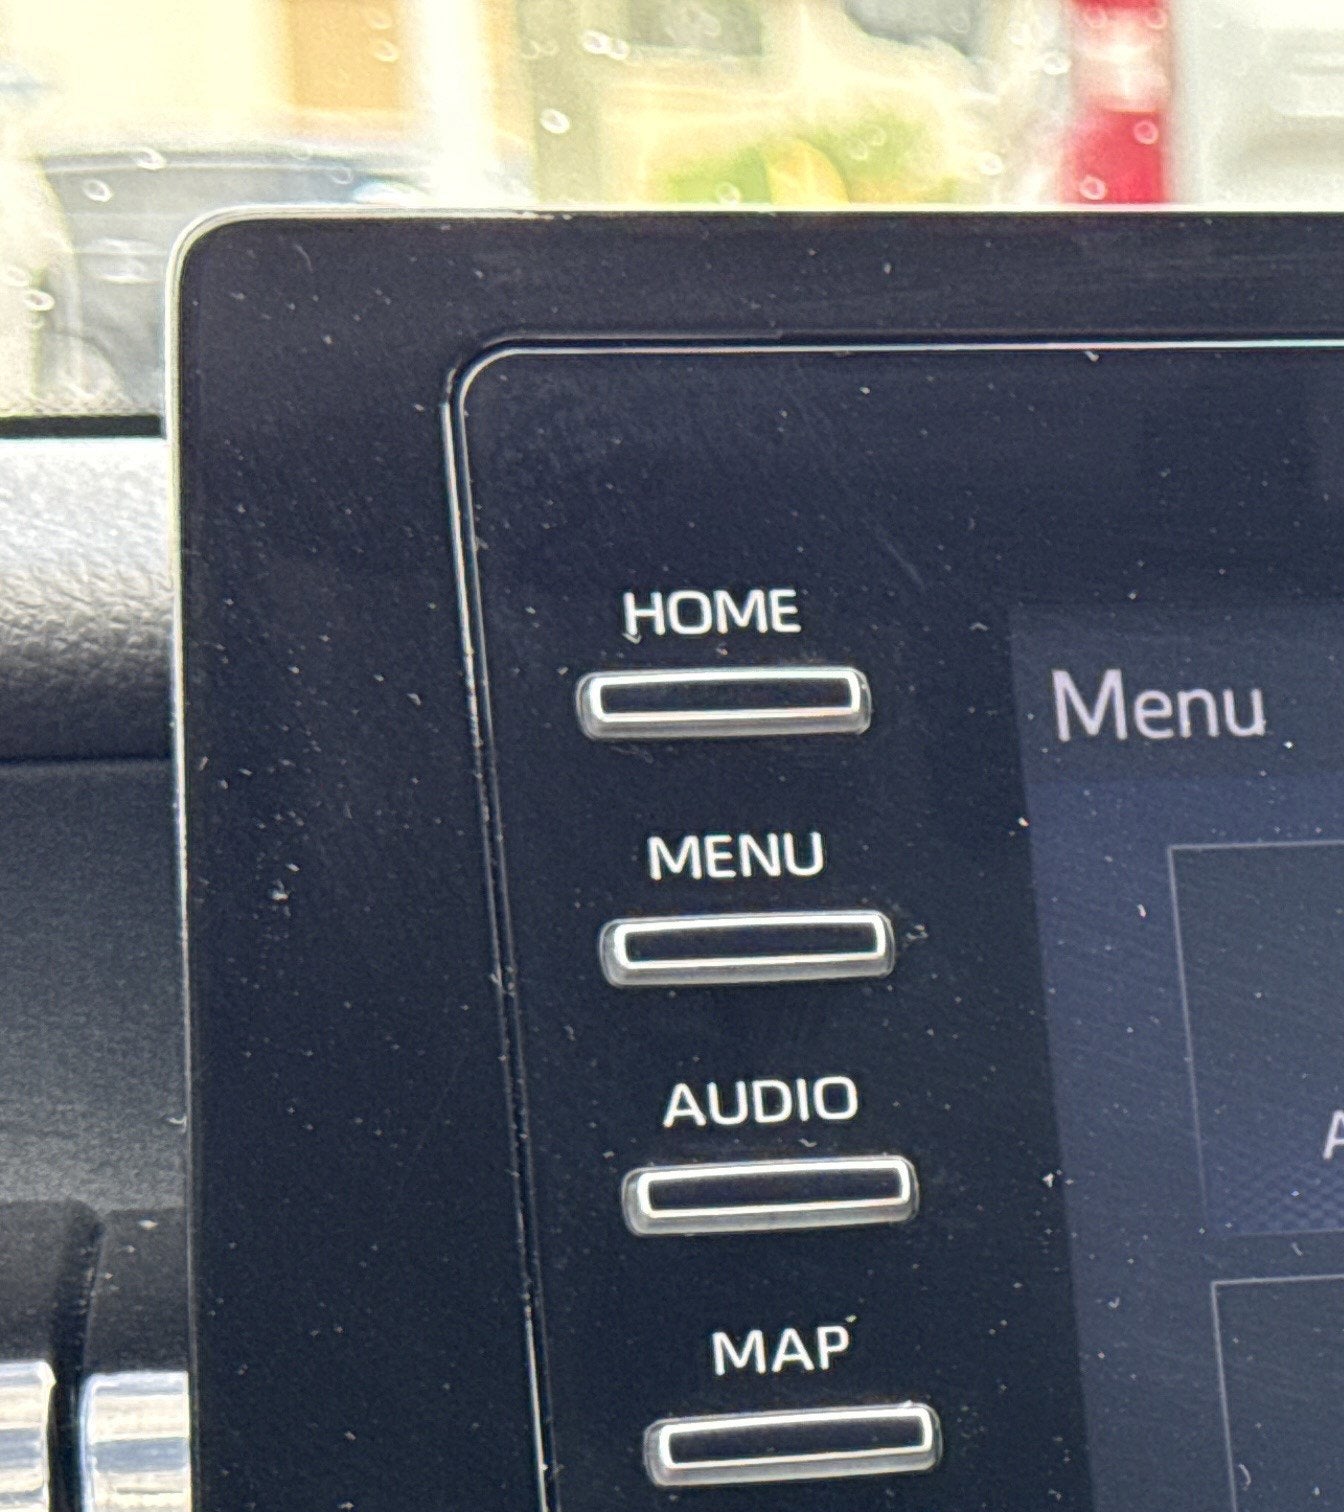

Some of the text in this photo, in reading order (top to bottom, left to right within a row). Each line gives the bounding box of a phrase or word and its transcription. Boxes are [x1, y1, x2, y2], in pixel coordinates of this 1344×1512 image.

[622, 589, 802, 637] HOME
[1052, 668, 1268, 742] Menu
[647, 831, 825, 880] MENU
[662, 1075, 859, 1128] AUDIO
[711, 1323, 852, 1376] MAP
